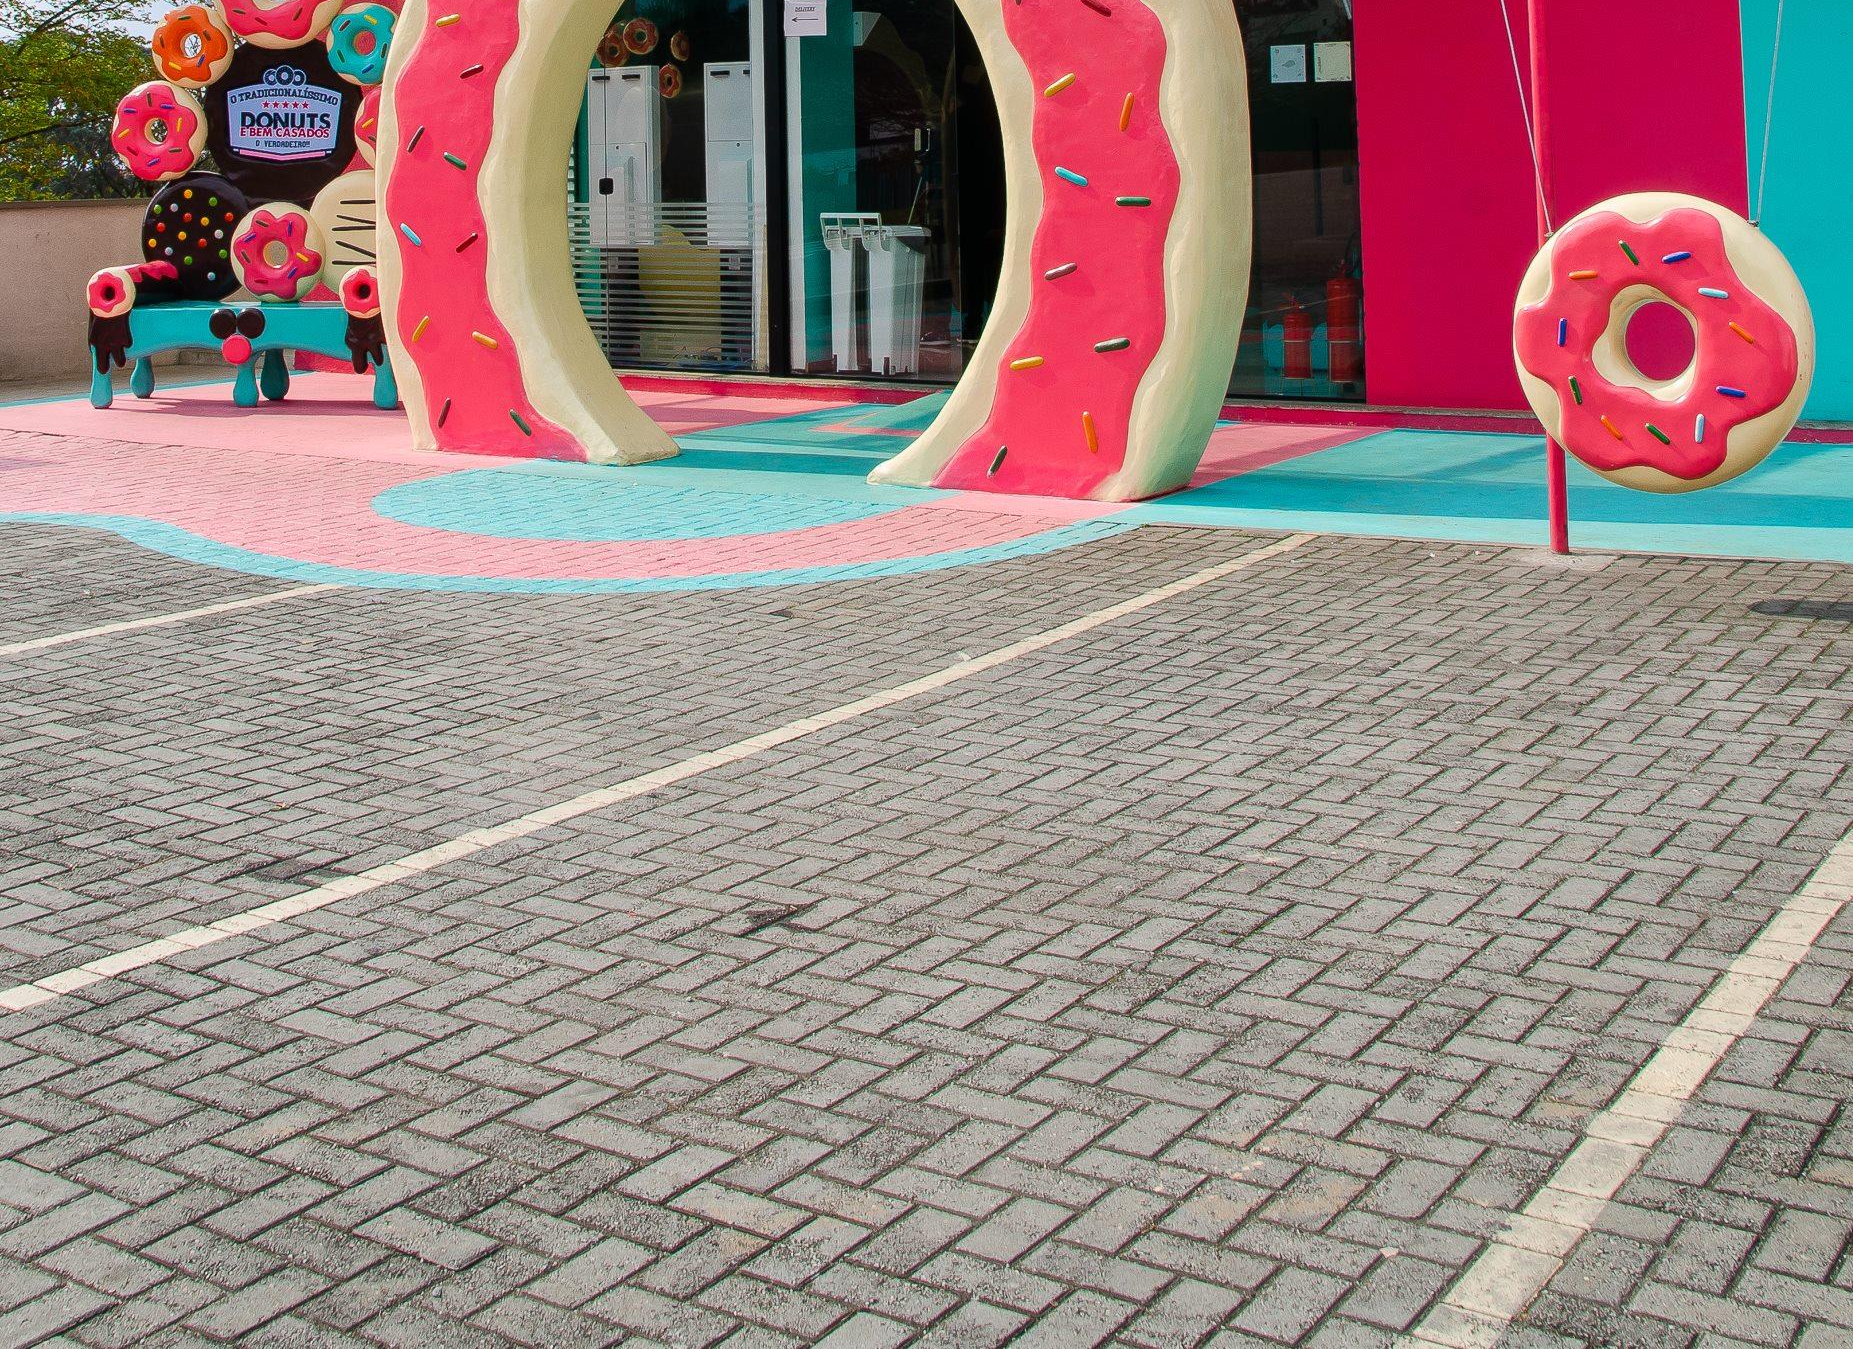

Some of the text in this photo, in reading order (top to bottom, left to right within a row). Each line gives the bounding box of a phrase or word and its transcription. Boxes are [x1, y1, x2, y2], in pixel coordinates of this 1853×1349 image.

[230, 87, 339, 106] O TRADICIONALÍSSIMO
[241, 112, 331, 129] DONUTS
[240, 127, 330, 138] E BEM CASADOS
